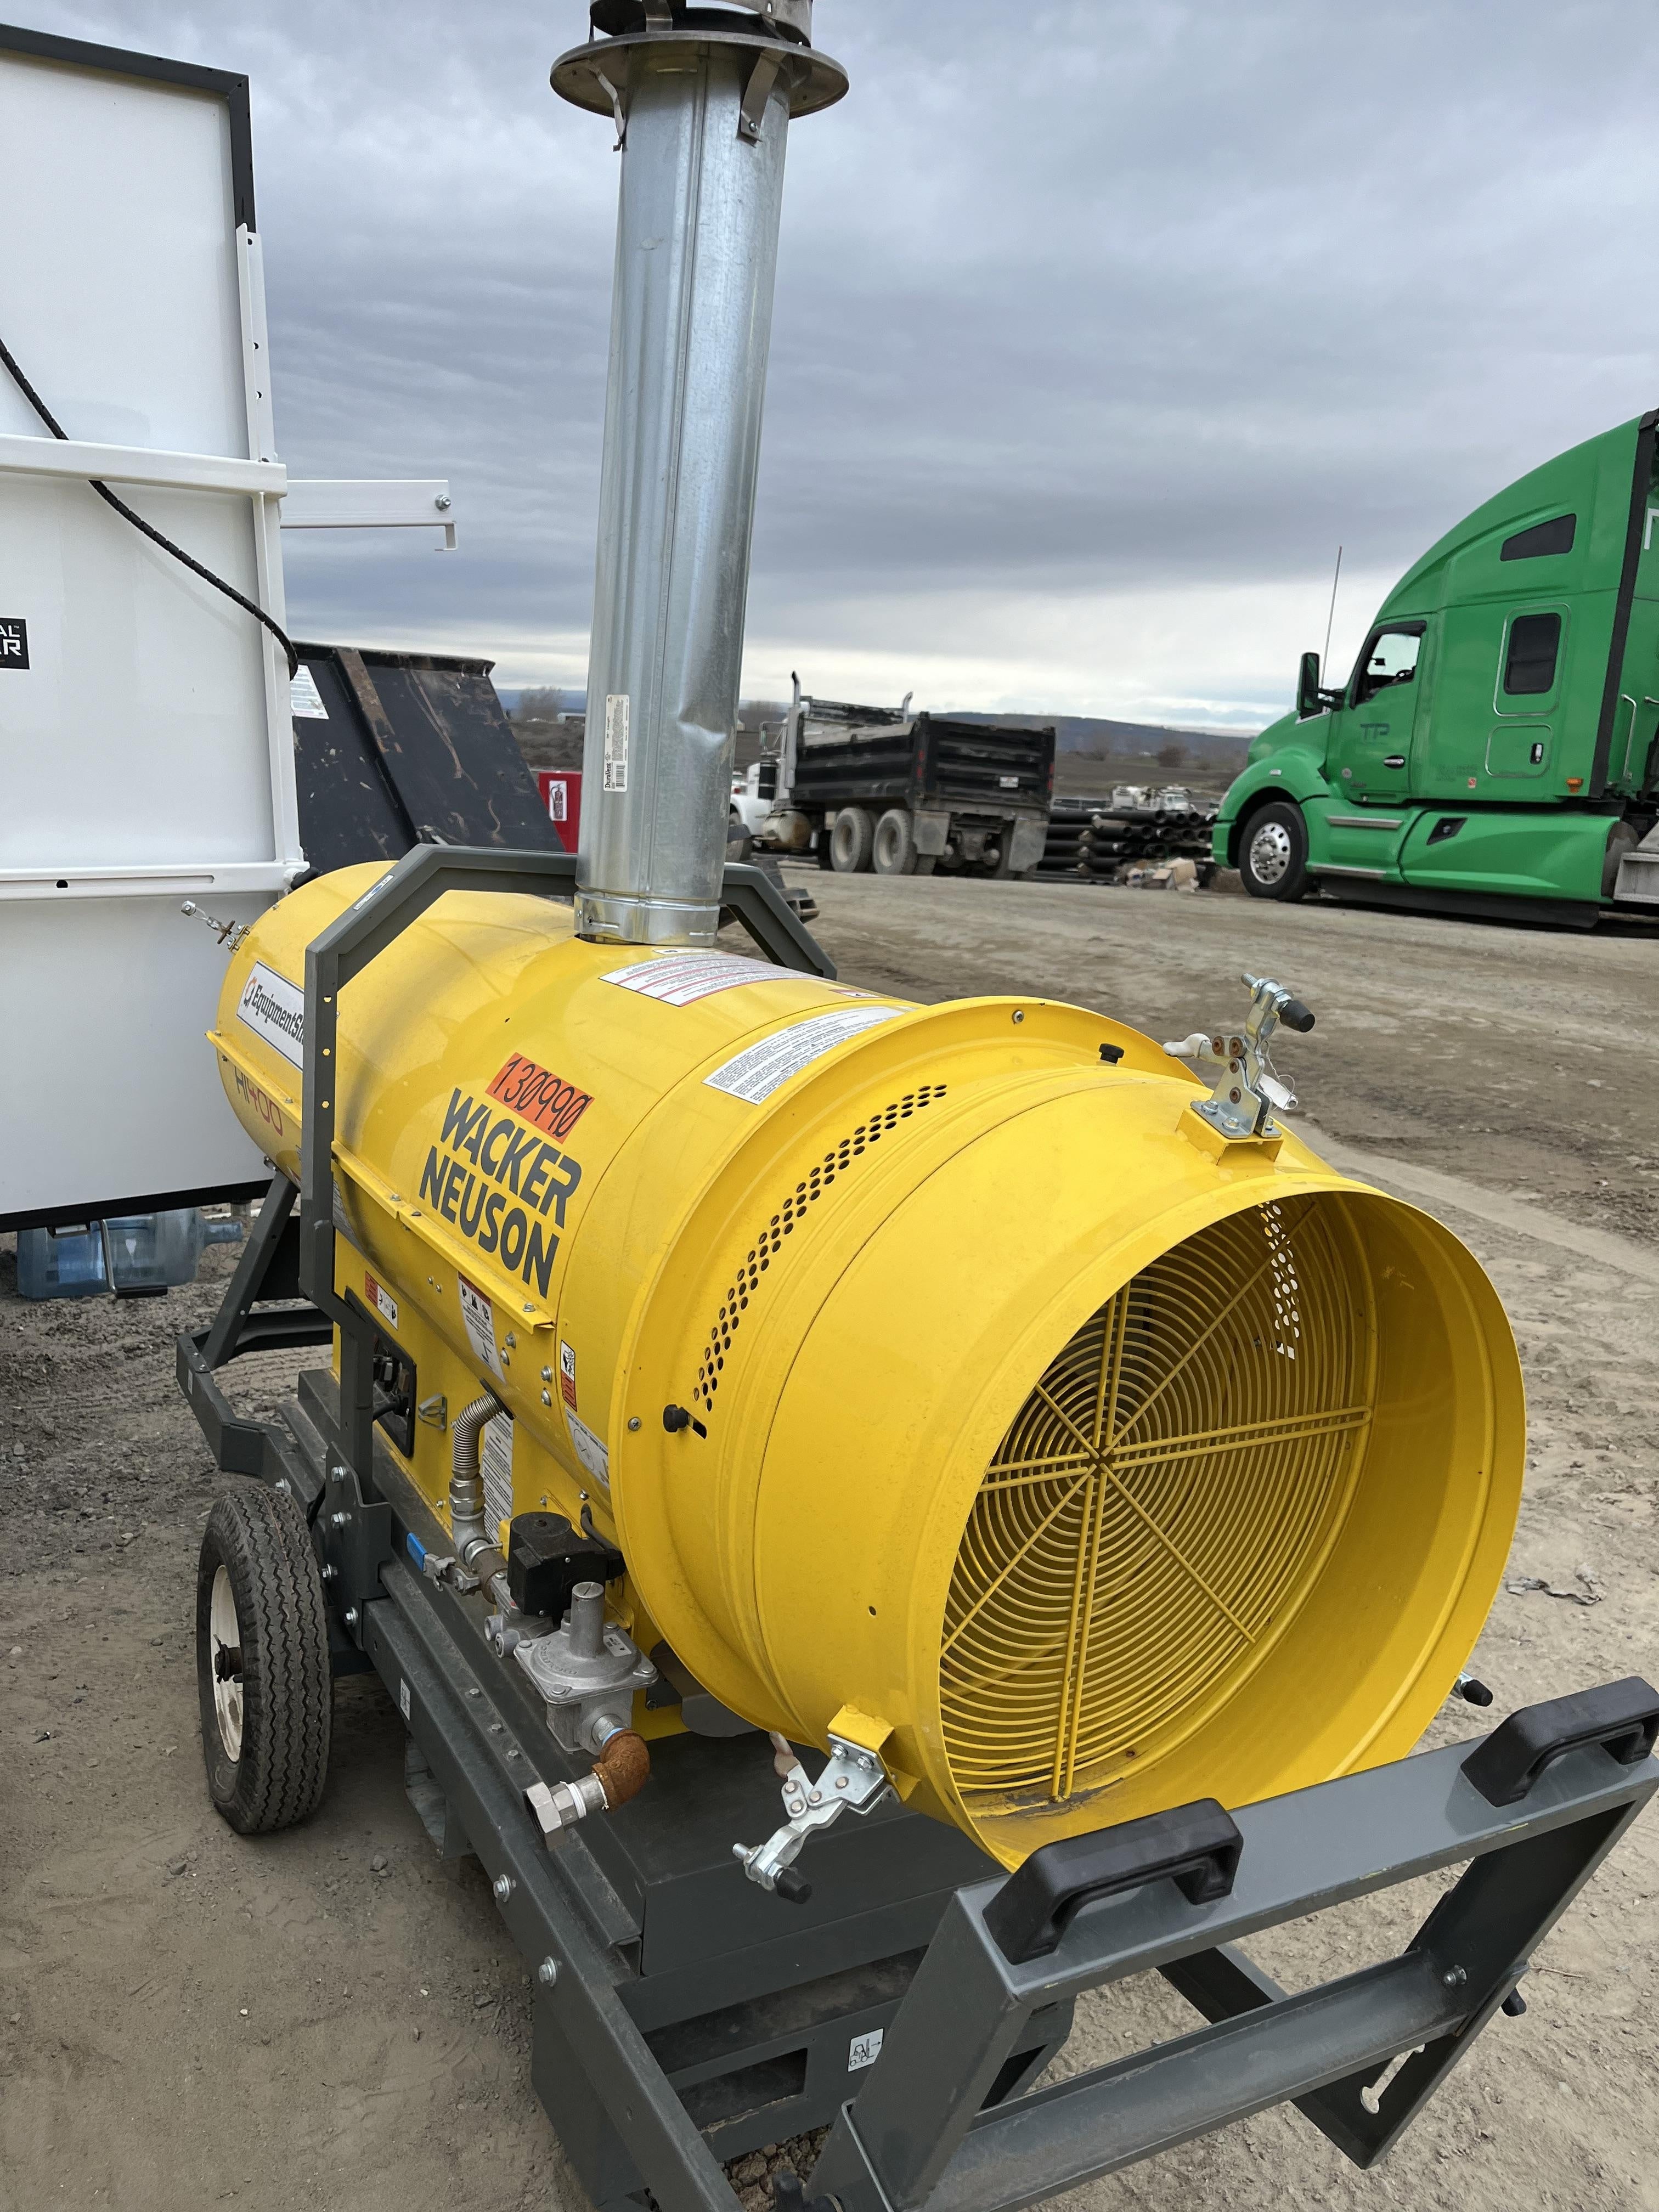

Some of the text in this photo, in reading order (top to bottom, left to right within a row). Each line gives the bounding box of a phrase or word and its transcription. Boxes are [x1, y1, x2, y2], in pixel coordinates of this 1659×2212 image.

[251, 984, 304, 1045] EquipmentSh
[419, 1146, 560, 1299] NEUSON
[440, 1088, 583, 1229] WACKER
